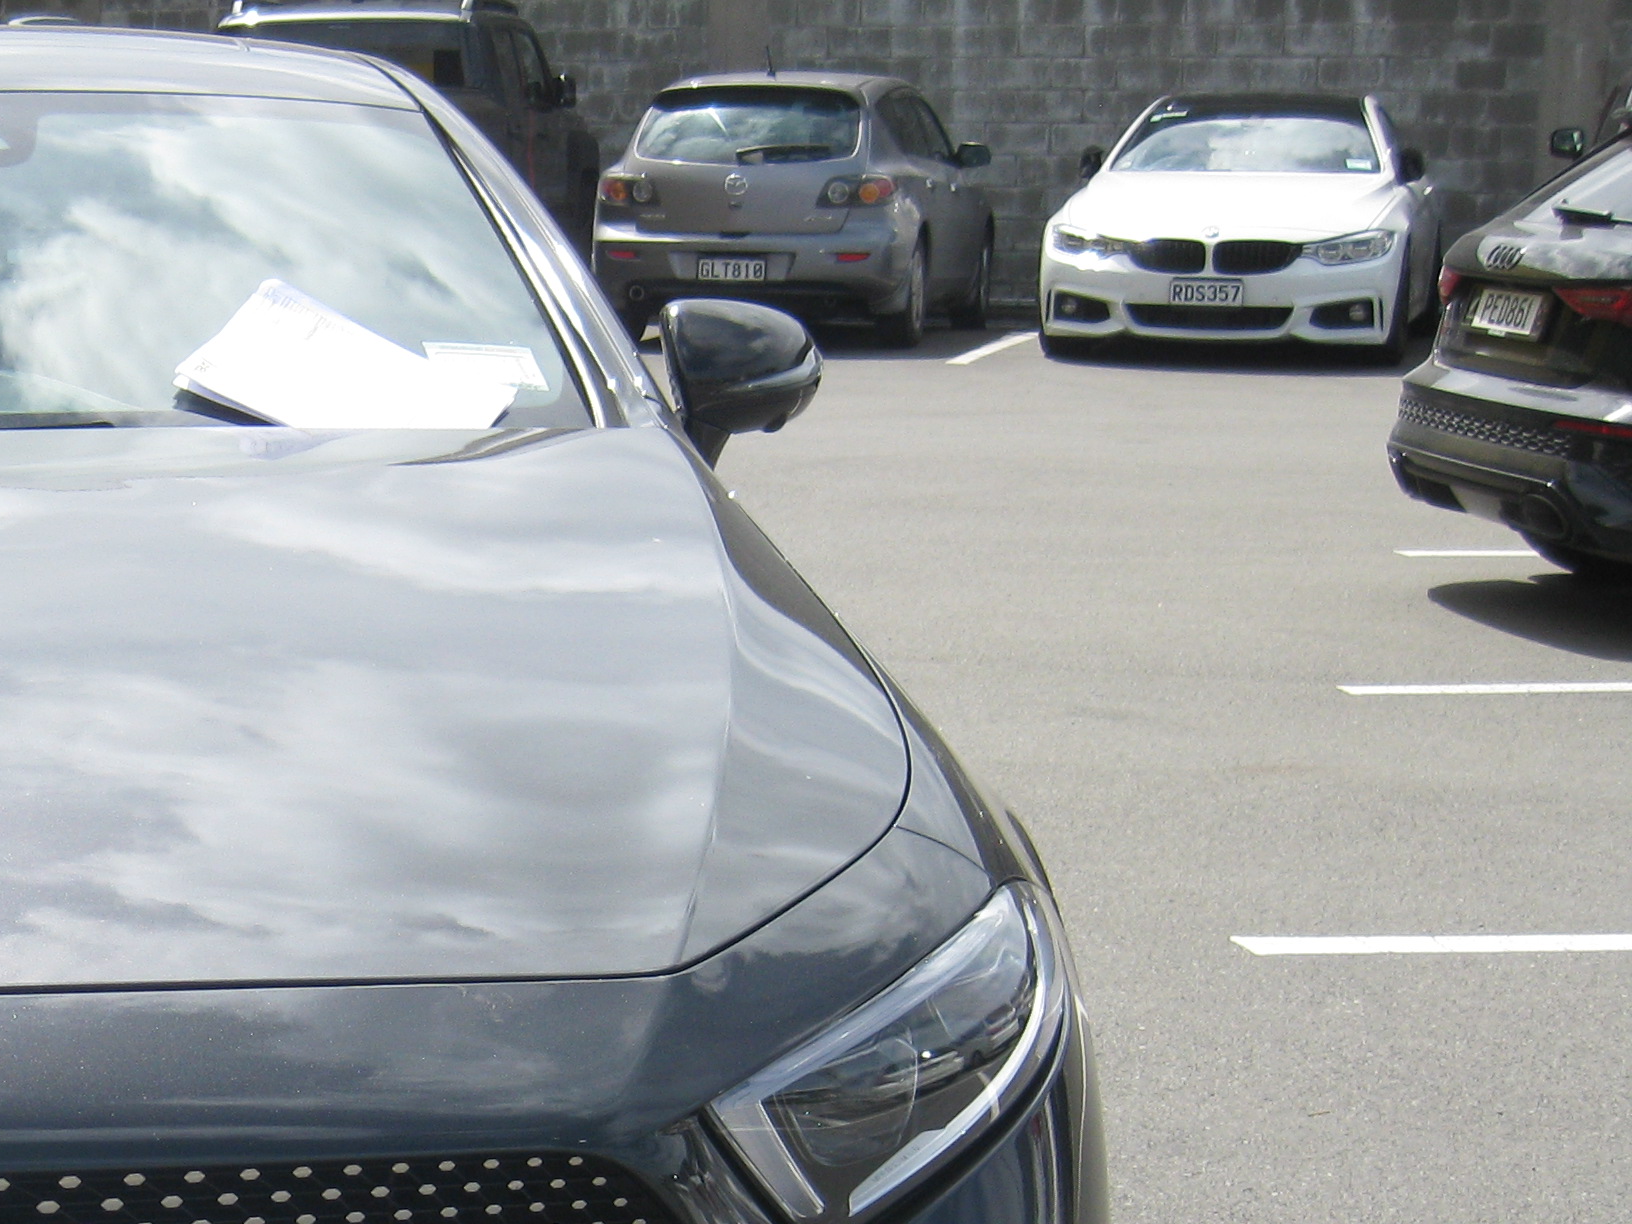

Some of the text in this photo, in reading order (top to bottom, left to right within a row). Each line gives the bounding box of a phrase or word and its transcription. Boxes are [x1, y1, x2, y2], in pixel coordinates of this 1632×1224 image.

[700, 261, 763, 279] GLT810
[1172, 284, 1241, 302] RDS357
[1480, 293, 1534, 329] PED861
